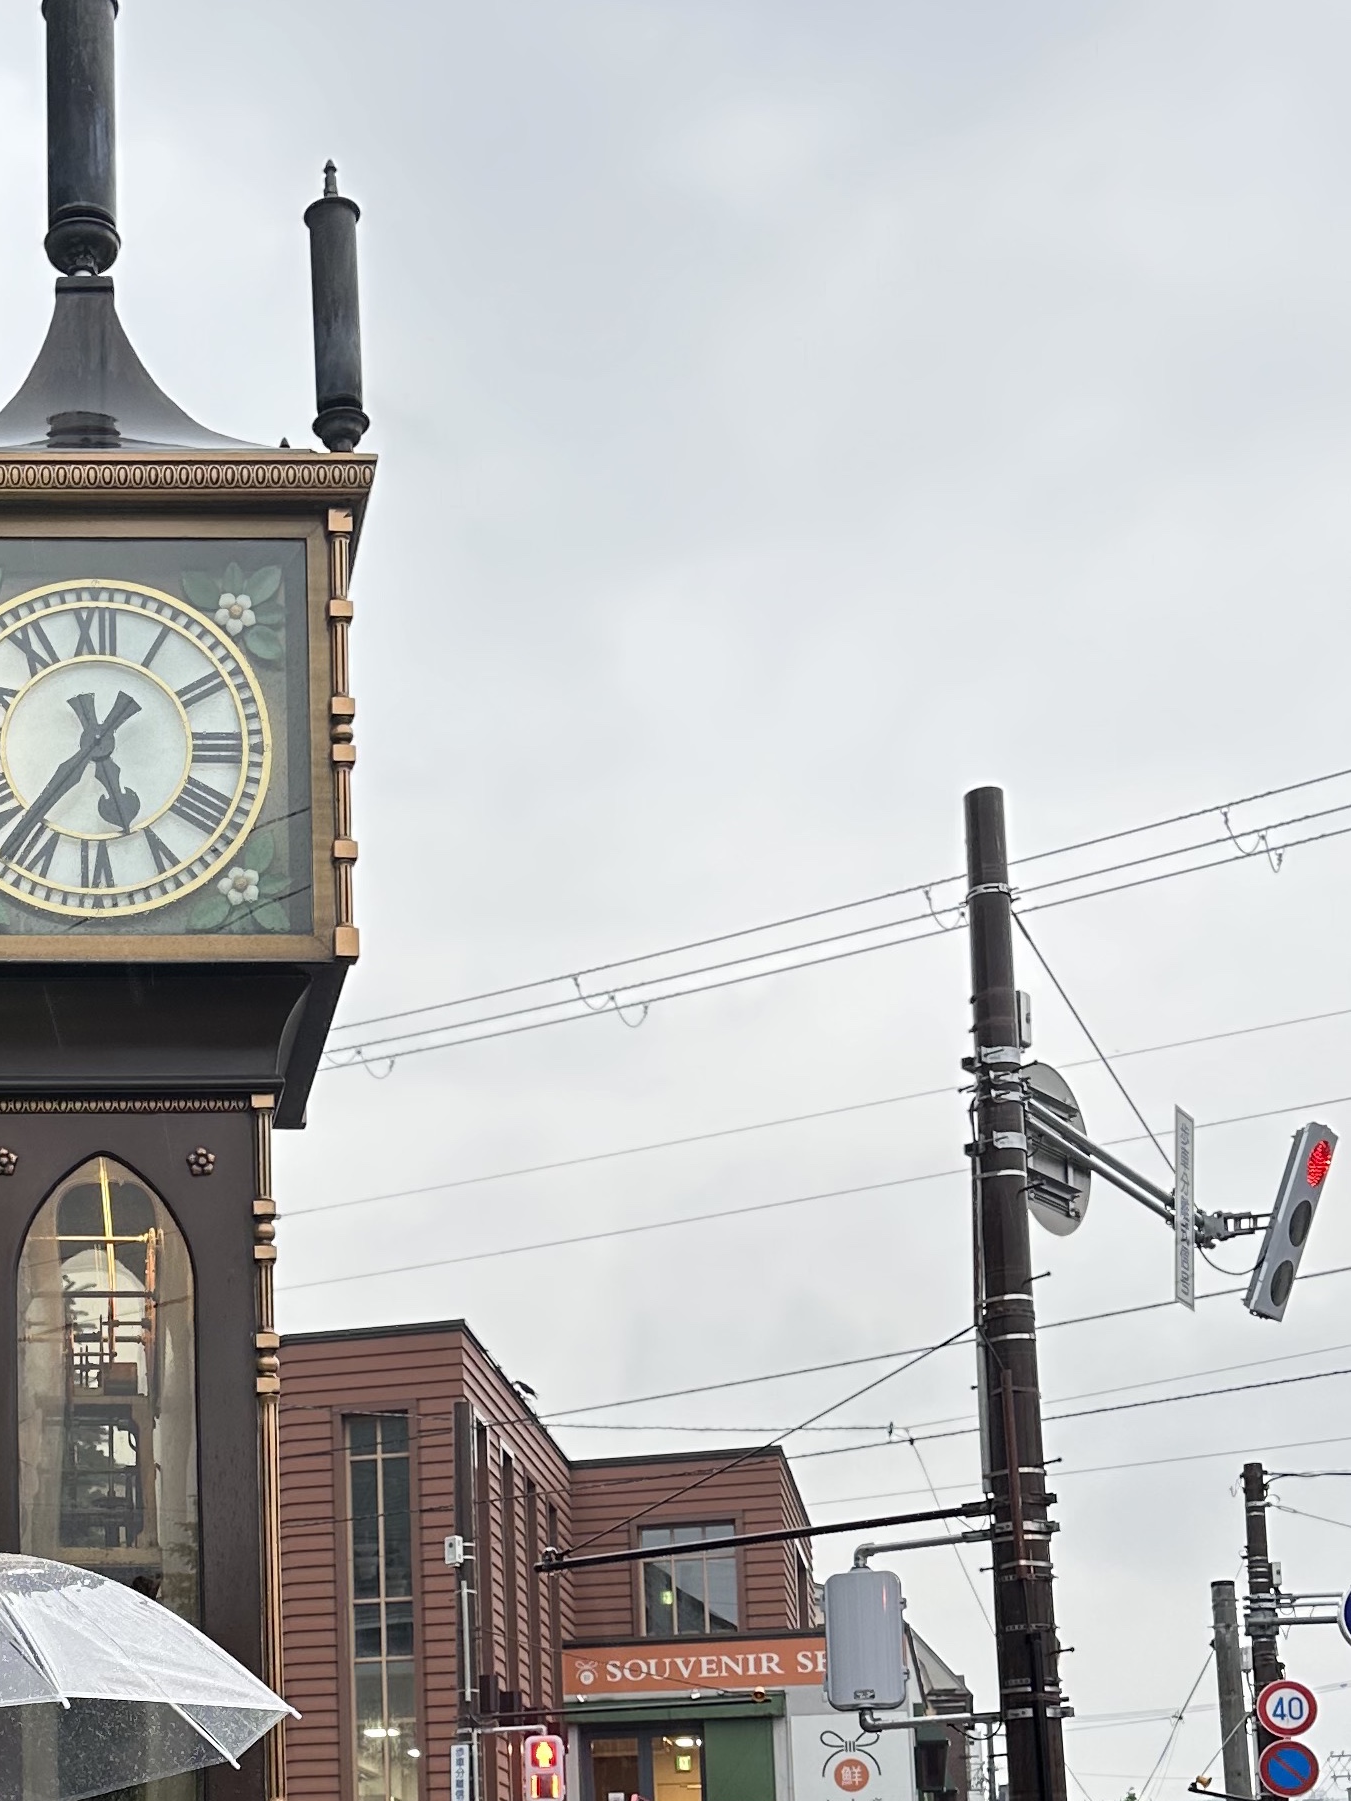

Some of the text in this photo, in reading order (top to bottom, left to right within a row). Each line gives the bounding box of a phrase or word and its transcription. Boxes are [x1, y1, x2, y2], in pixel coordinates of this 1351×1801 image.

[606, 1653, 784, 1682] SOUVENIR
[1272, 1696, 1304, 1721] 40
[841, 1766, 862, 1786] 鮮
